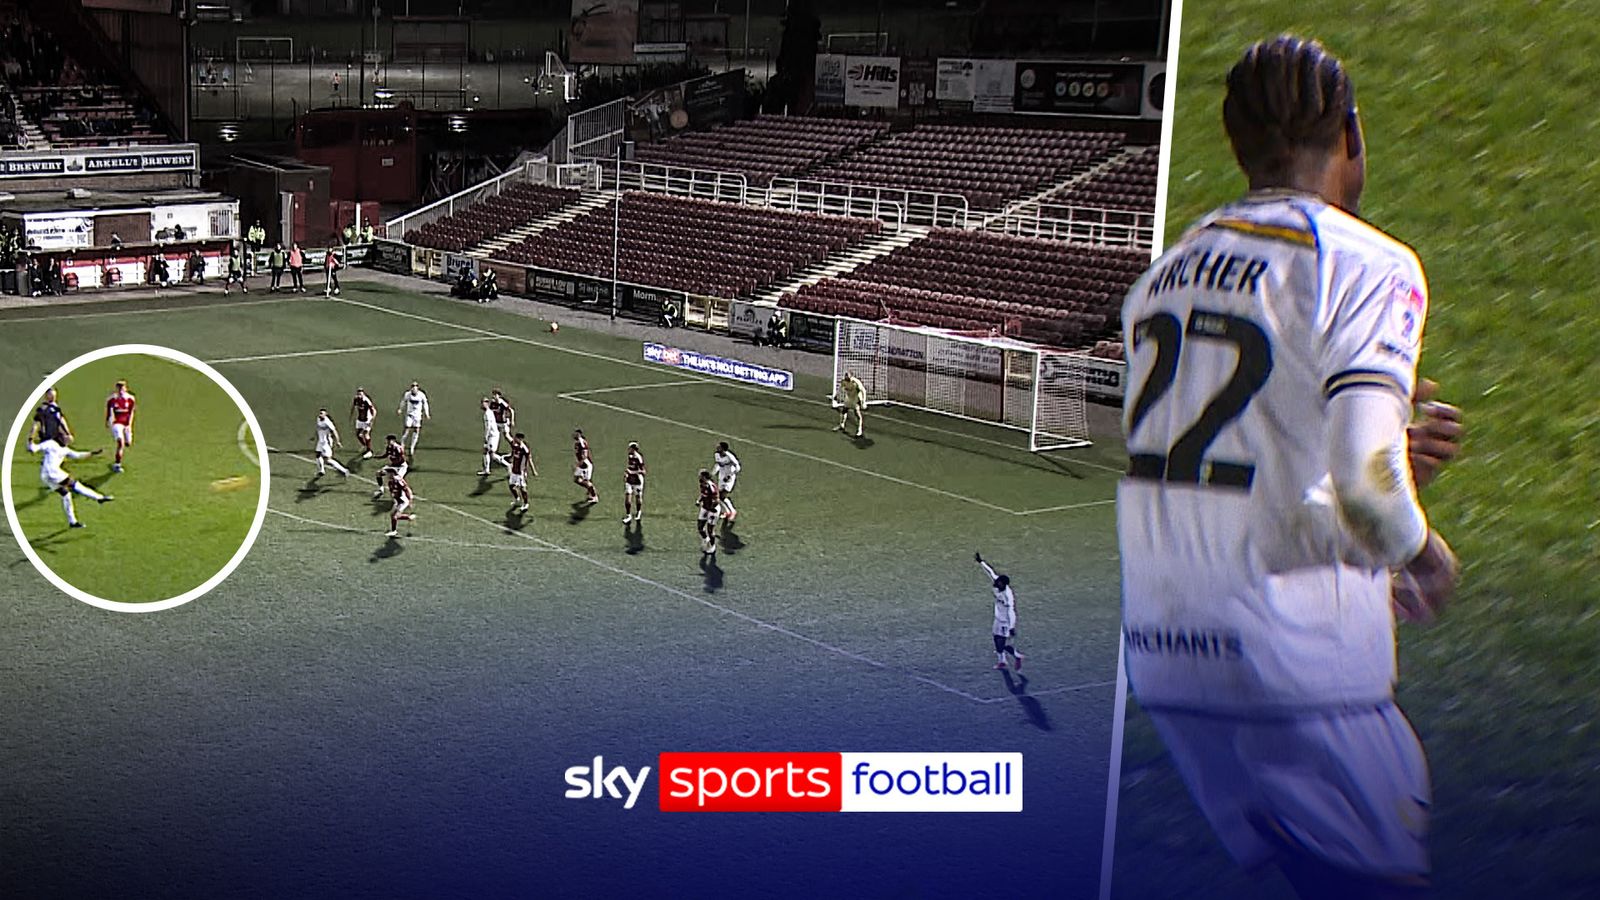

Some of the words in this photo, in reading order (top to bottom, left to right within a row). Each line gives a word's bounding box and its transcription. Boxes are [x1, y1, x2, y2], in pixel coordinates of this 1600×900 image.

[864, 65, 898, 83] Hills
[8, 161, 63, 173] BREWERY
[141, 154, 192, 168] BREWERY
[1147, 251, 1268, 298] ARCHER
[769, 371, 787, 384] APP
[1127, 309, 1273, 493] 22
